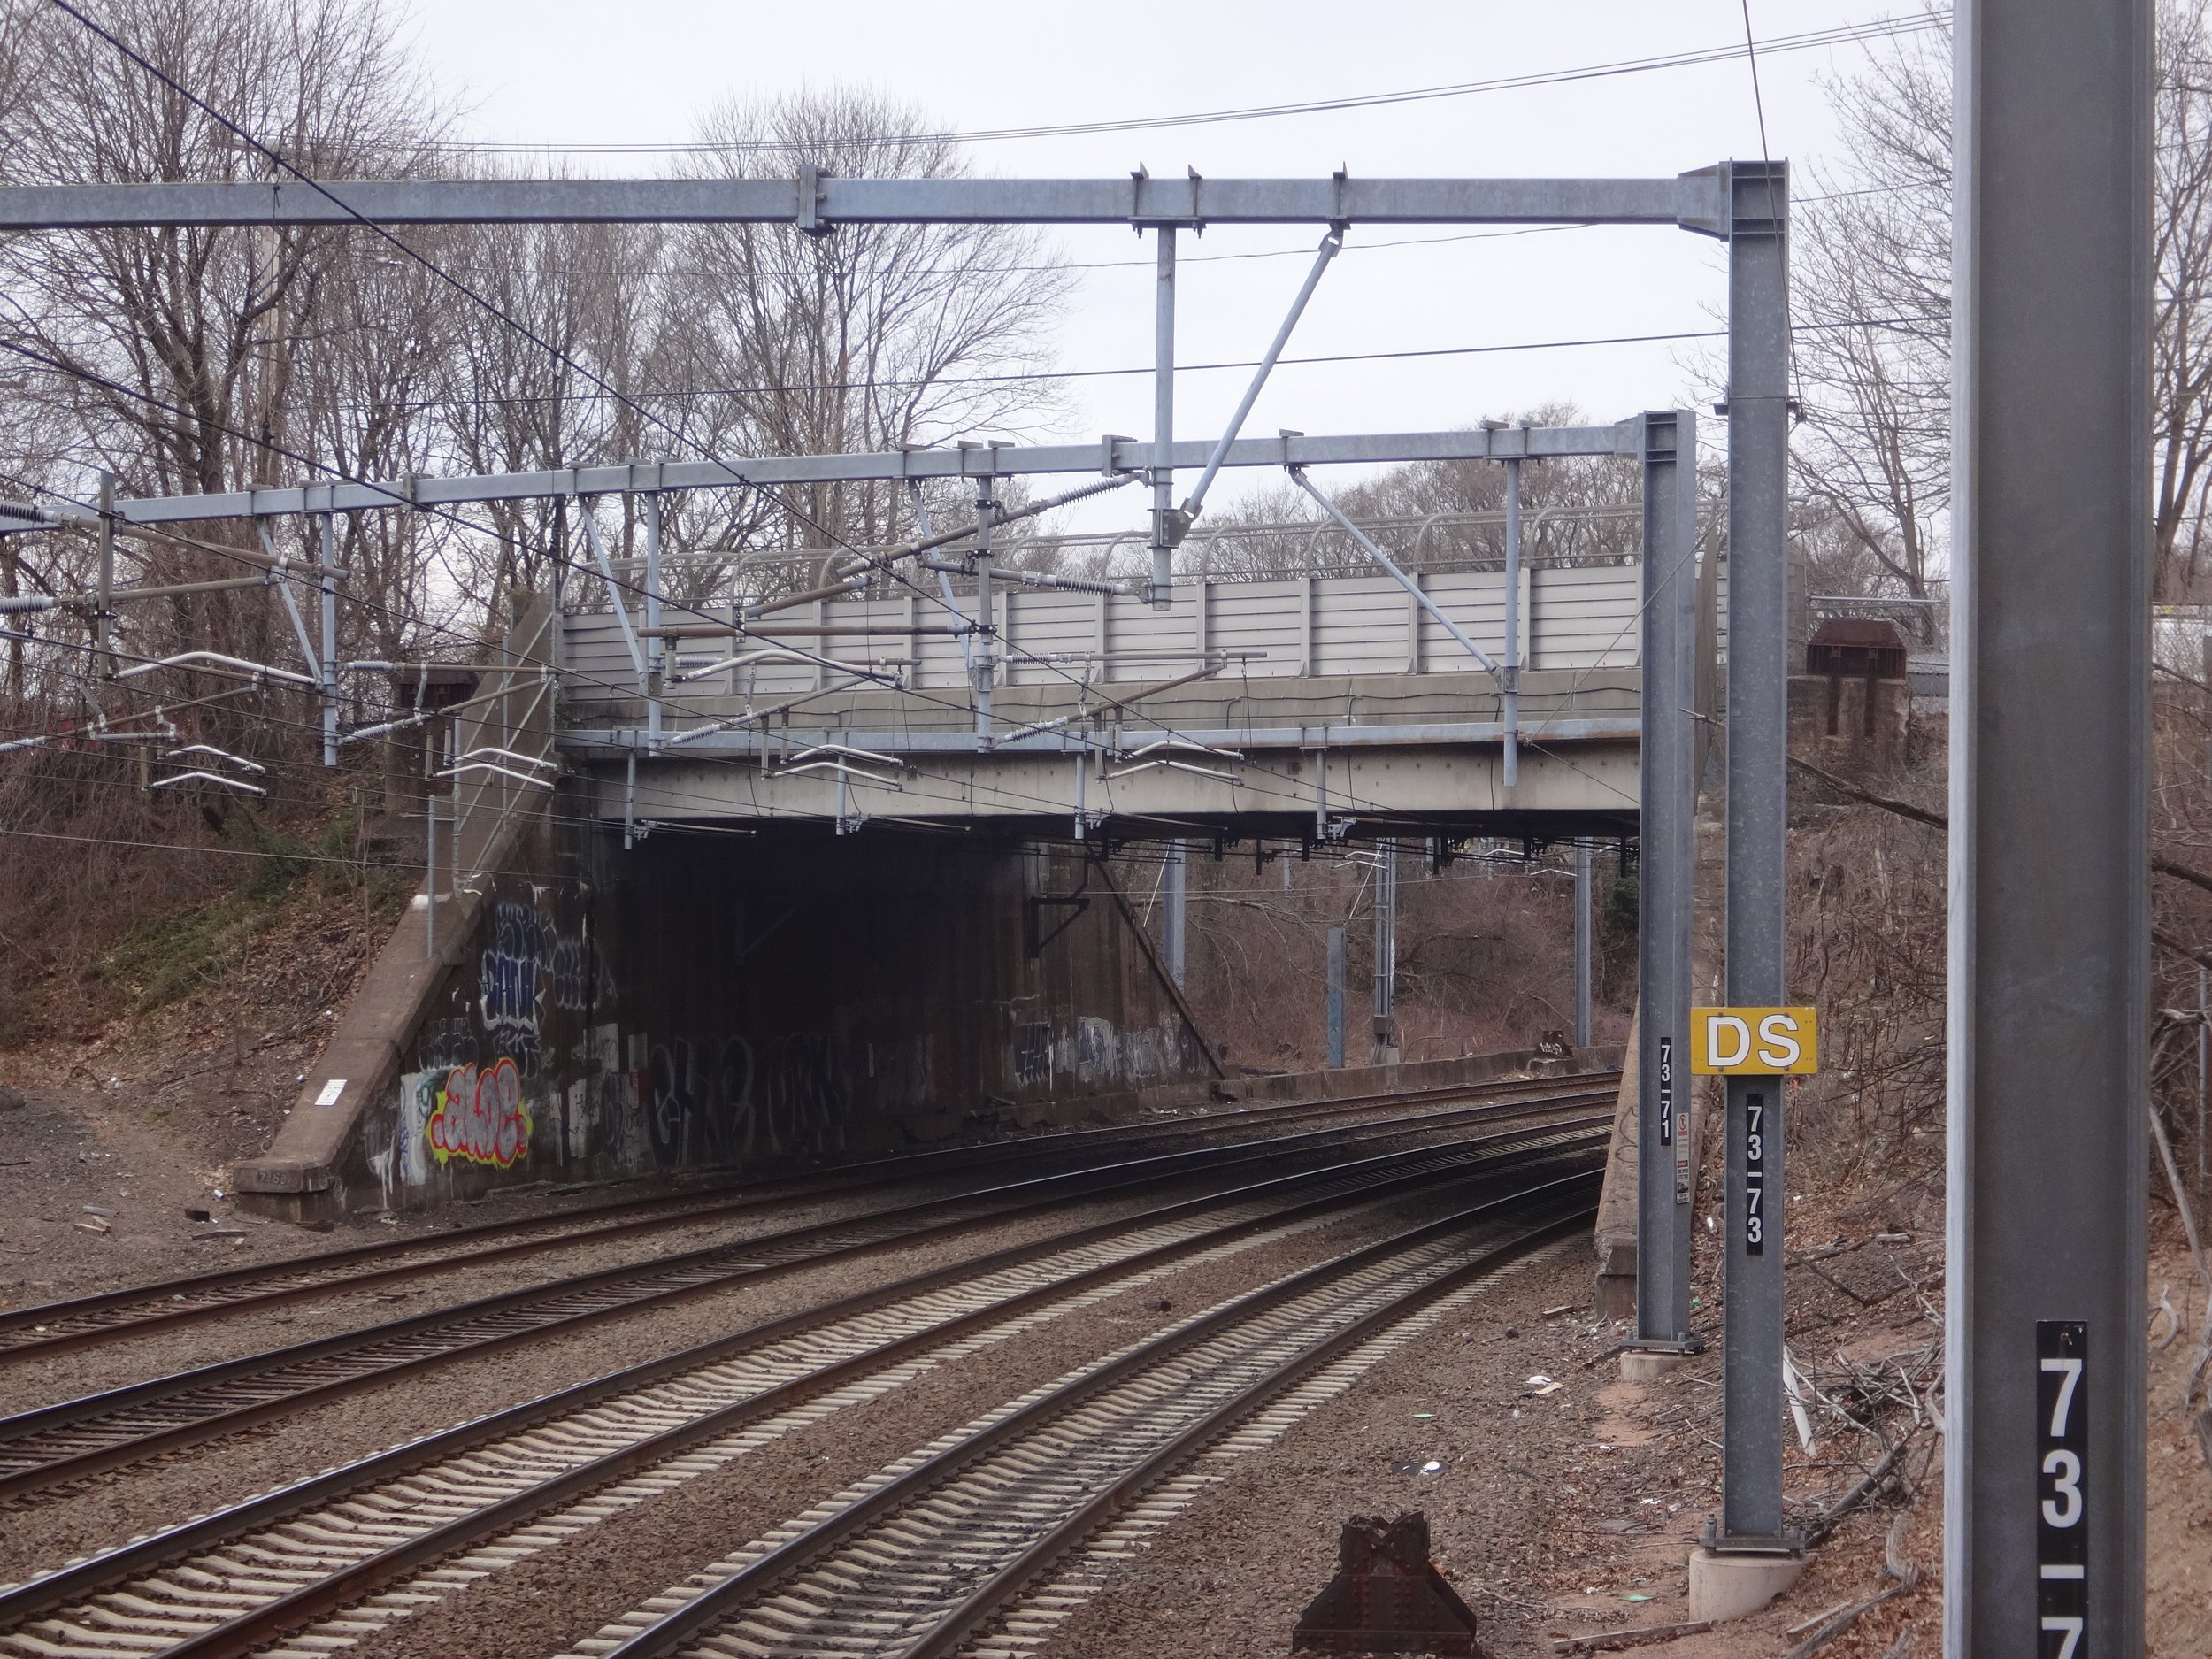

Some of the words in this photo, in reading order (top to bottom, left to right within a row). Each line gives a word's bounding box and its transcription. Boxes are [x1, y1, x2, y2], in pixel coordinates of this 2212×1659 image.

[1707, 1014, 1801, 1068] DS
[1660, 1044, 1671, 1138] 73-71
[1746, 1106, 1763, 1243] 73-73
